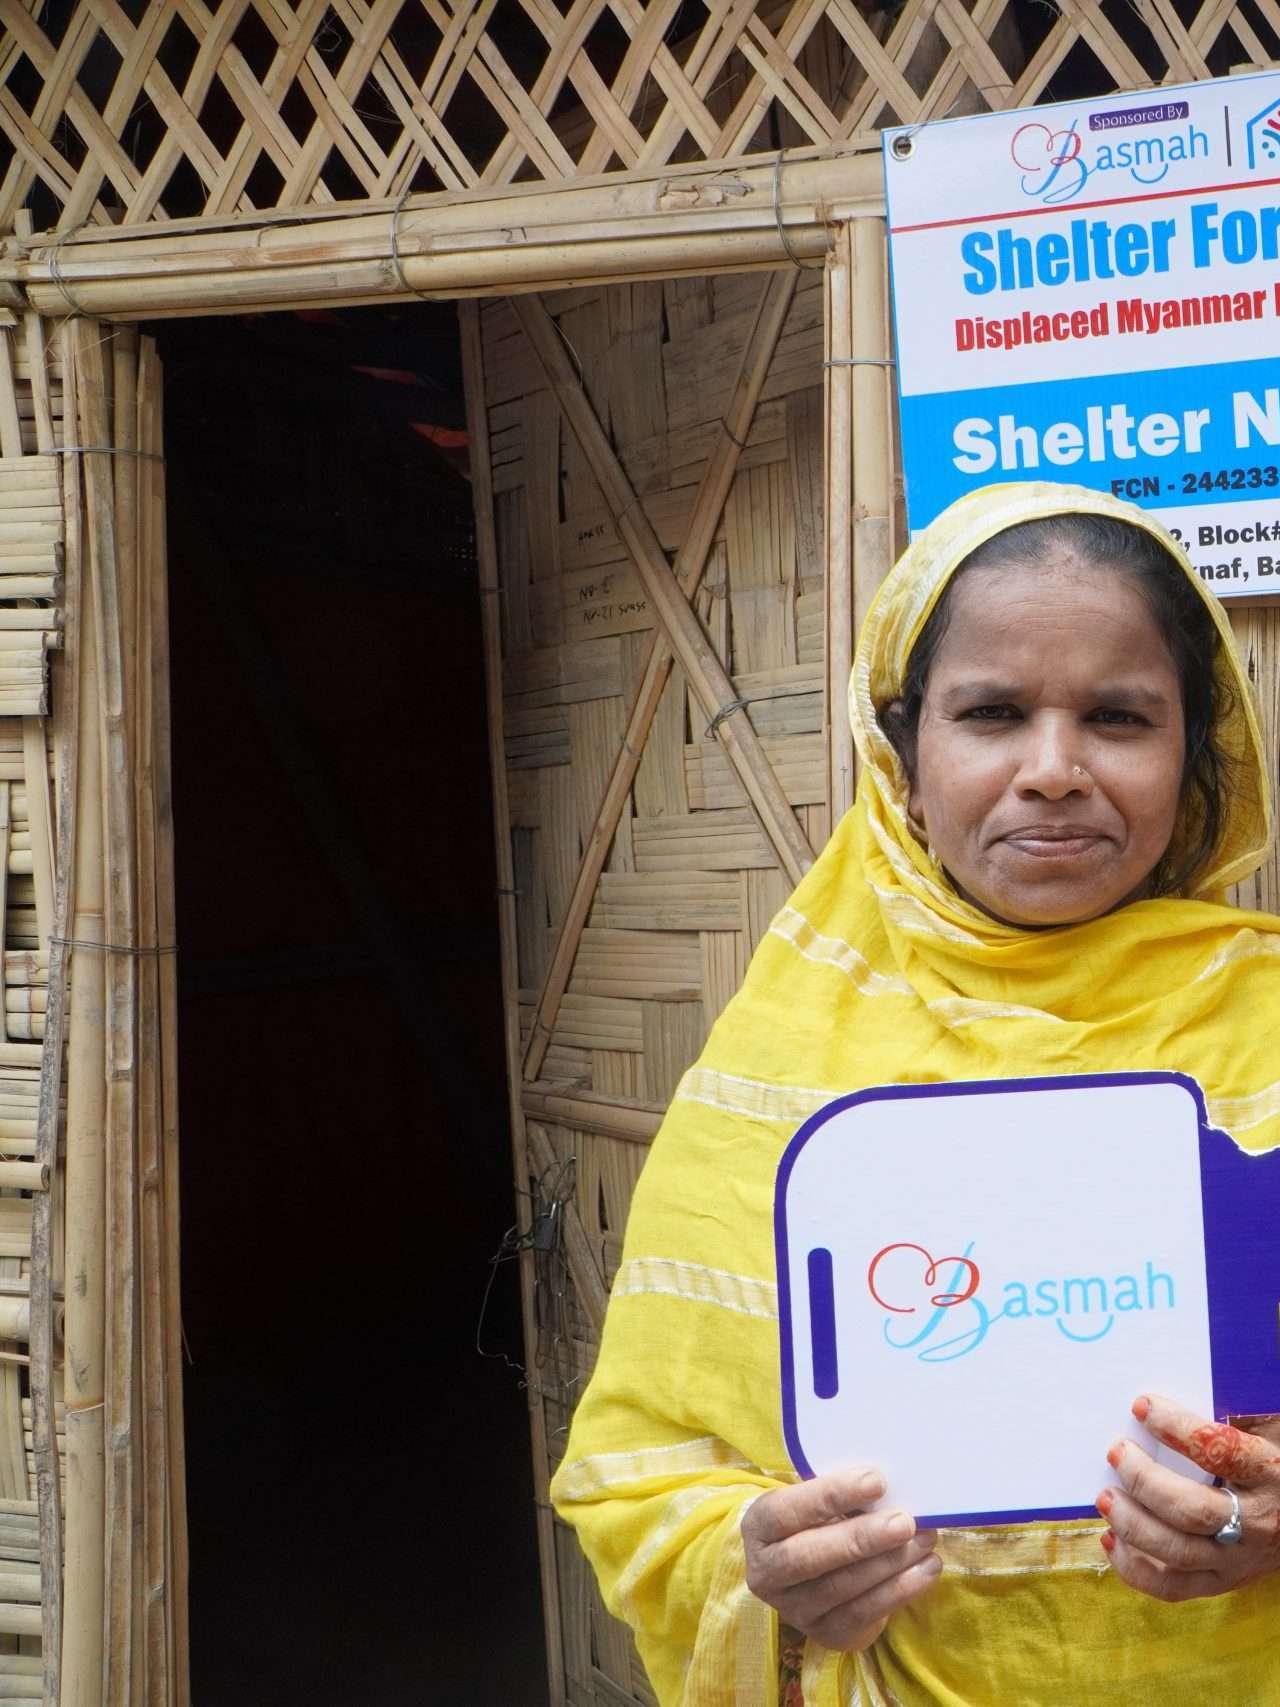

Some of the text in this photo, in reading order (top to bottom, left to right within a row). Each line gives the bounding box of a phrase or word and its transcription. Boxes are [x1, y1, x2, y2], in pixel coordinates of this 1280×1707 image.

[1093, 105, 1184, 130] Sponsored By
[1011, 119, 1209, 204] Basmah
[961, 219, 1177, 295] Shelter
[956, 302, 1110, 350] Displaced
[1116, 291, 1268, 333] Myanmar
[954, 405, 1210, 473] Shelter
[1111, 476, 1160, 498] FCN
[1182, 466, 1280, 493] 244233
[867, 1241, 1176, 1363] Basmah
